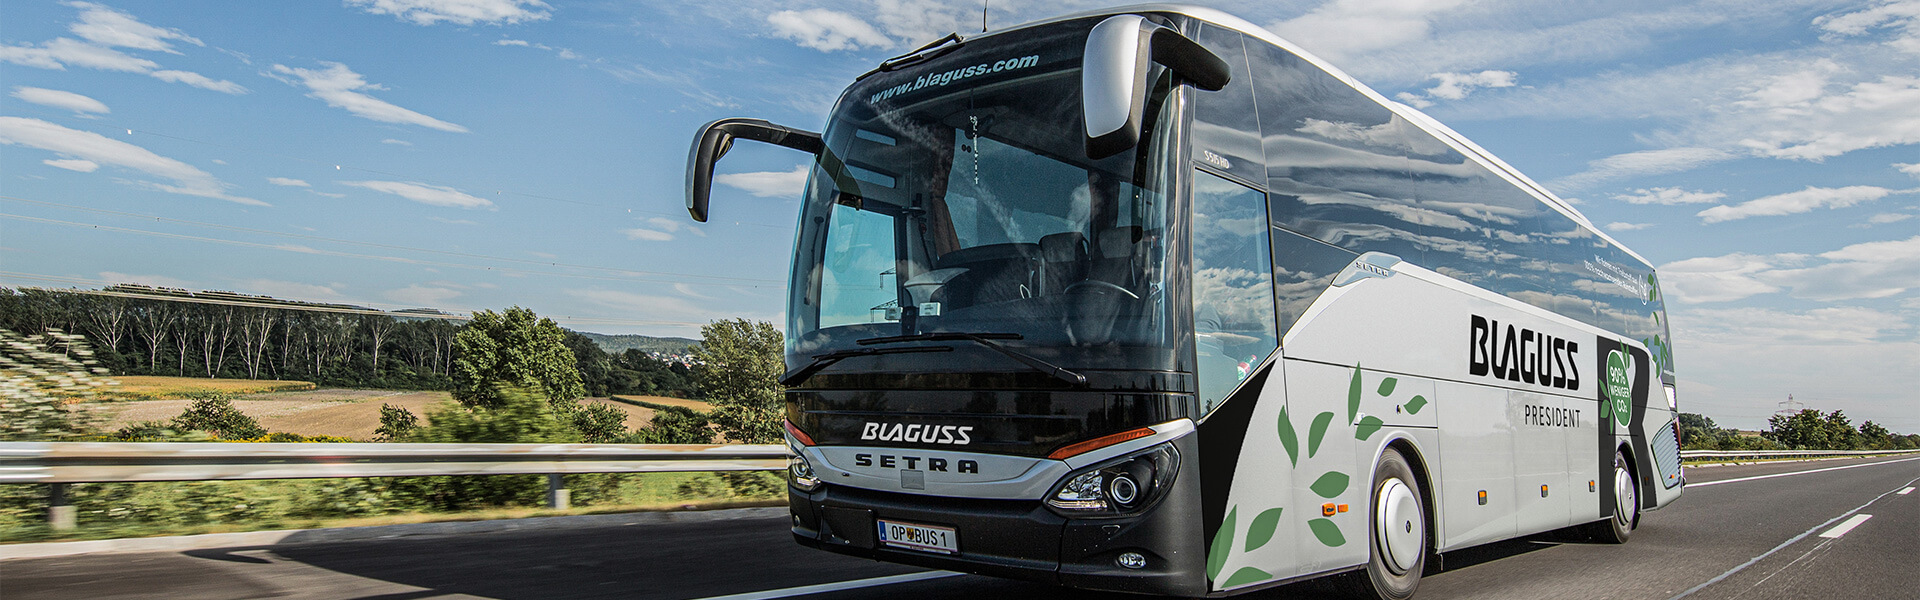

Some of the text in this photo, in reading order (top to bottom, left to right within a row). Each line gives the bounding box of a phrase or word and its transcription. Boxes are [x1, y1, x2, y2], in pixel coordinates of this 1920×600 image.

[870, 54, 1040, 105] www.blaguss.com
[1203, 150, 1210, 161] S
[1219, 156, 1230, 169] HD
[1355, 261, 1389, 277] SETRA
[1469, 314, 1580, 391] BLAGUSS
[1609, 366, 1626, 385] 90%
[1609, 384, 1630, 398] WENIGER
[1524, 404, 1581, 428] PRESIDENT
[860, 422, 974, 445] BLAGUSS
[855, 453, 979, 474] SETRA
[891, 525, 947, 547] OP BUS 1
